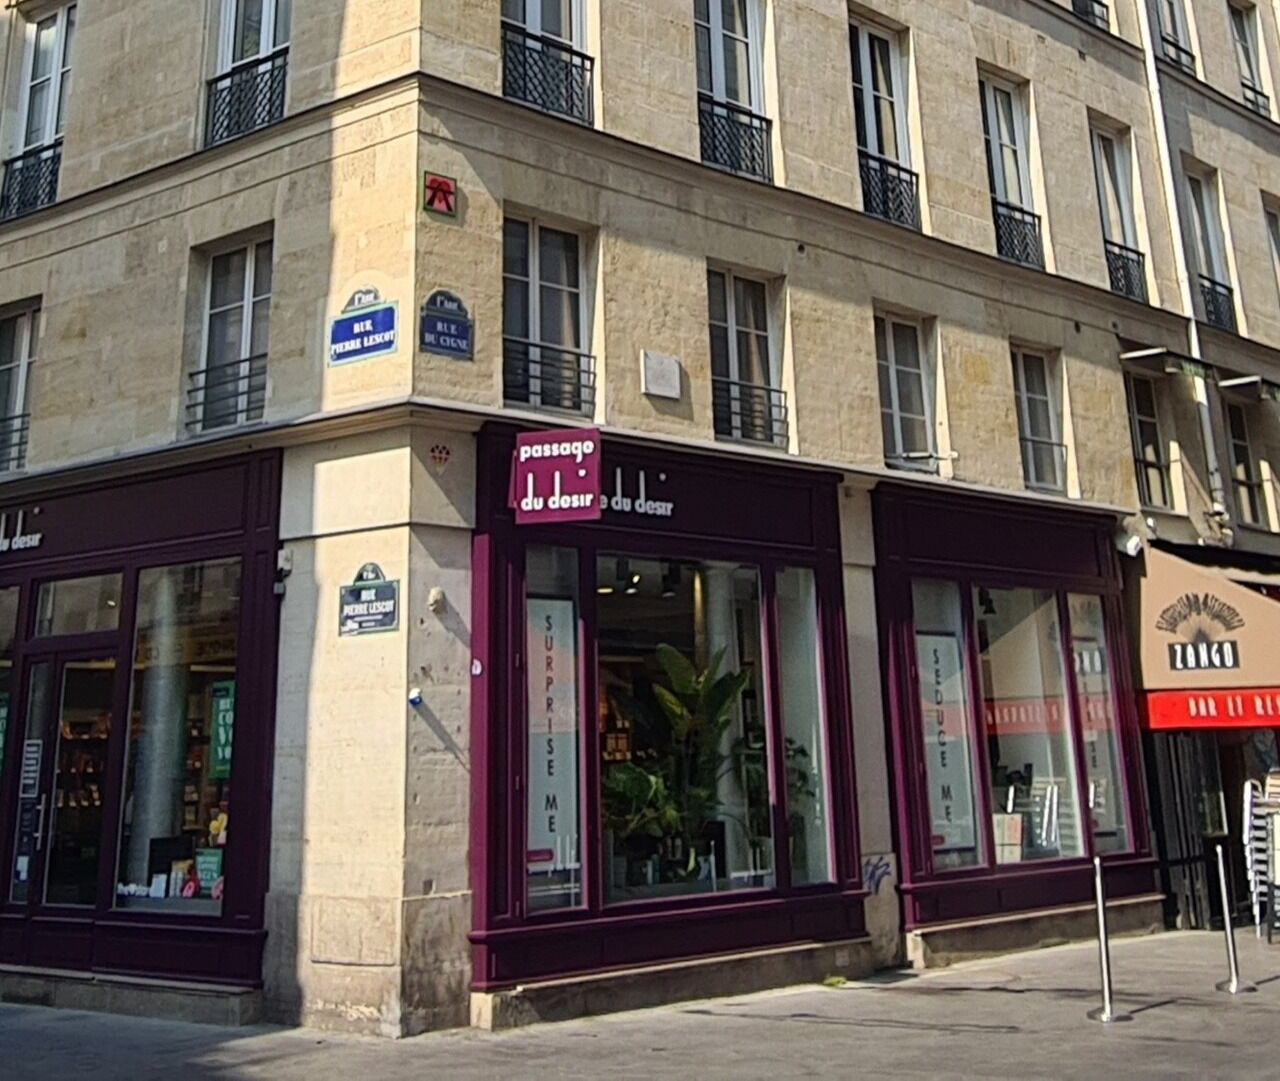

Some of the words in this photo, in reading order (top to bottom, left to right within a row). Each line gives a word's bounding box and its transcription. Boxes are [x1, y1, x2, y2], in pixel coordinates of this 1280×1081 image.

[353, 318, 374, 335] RUE
[436, 321, 458, 335] RUE
[331, 334, 362, 355] PIERRE
[363, 330, 395, 348] LESCOT
[424, 331, 438, 344] DU
[440, 335, 469, 350] CYGNE
[519, 439, 595, 464] passage
[520, 471, 544, 512] du
[610, 466, 633, 512] du
[1173, 641, 1235, 670] ZANGO
[543, 614, 556, 778] SURPRISE
[1187, 695, 1218, 718] BAR
[932, 648, 948, 769] SEDUCE
[940, 784, 953, 824] ME
[544, 793, 559, 834] ME
